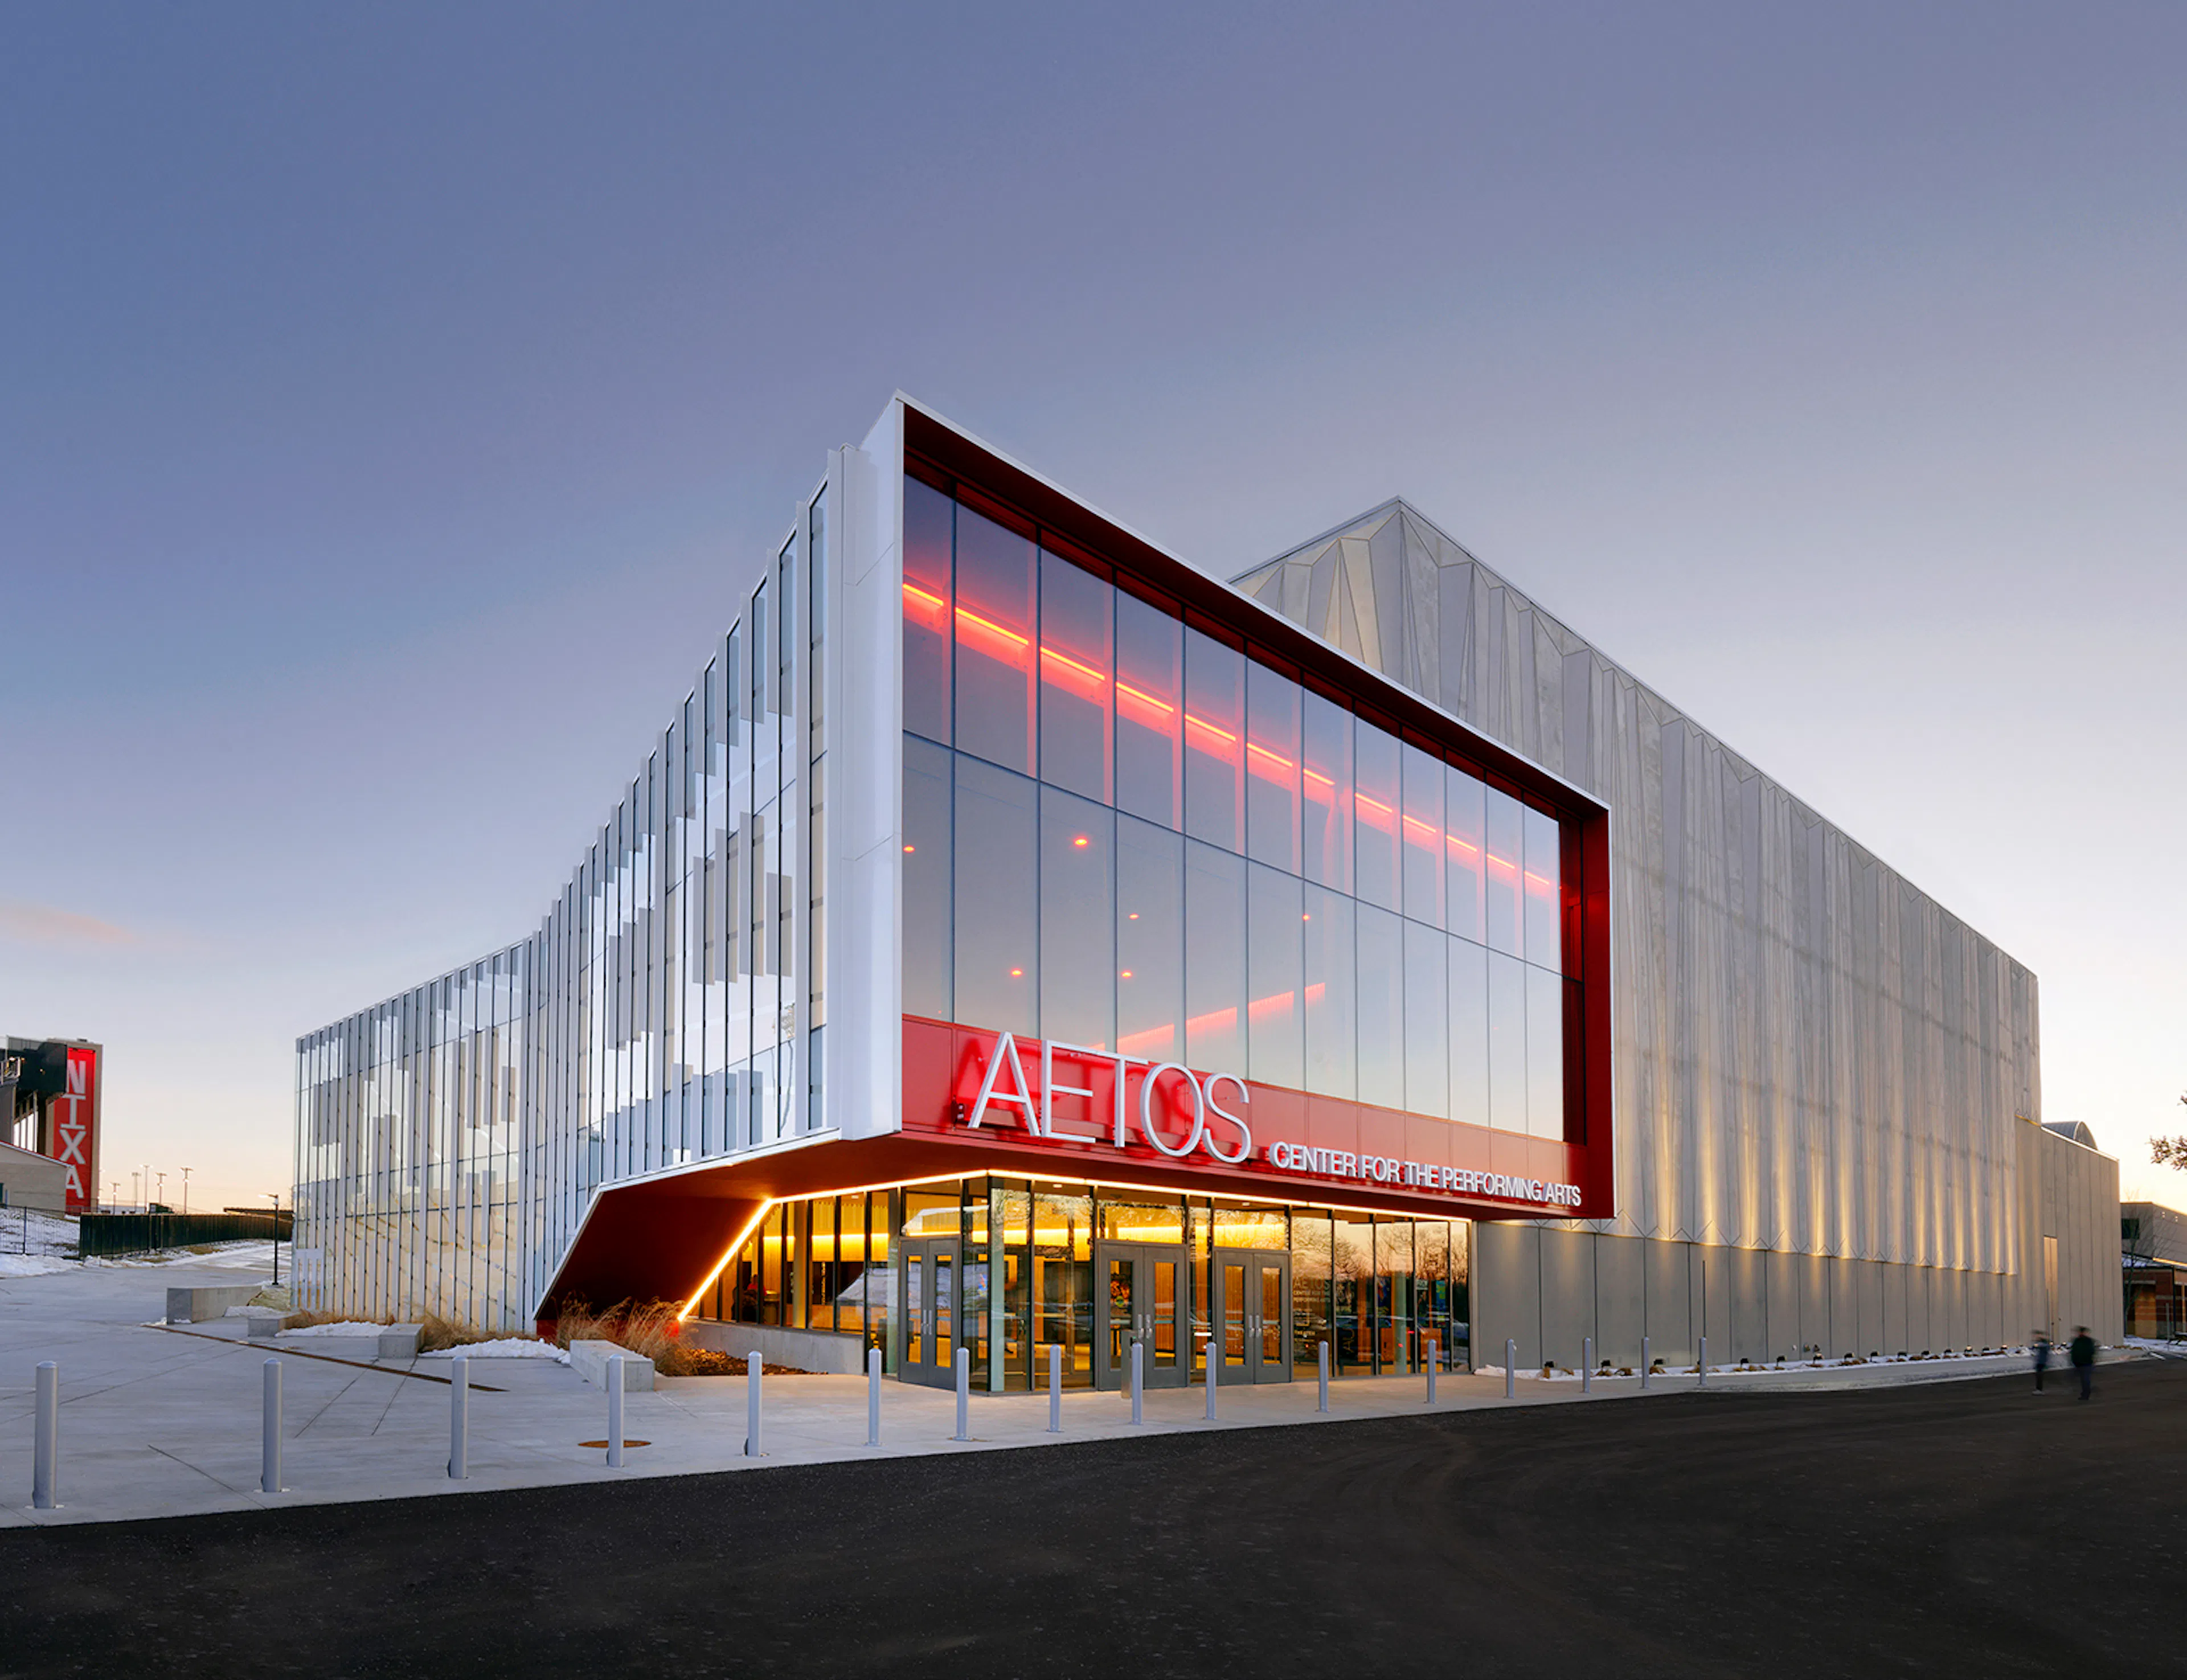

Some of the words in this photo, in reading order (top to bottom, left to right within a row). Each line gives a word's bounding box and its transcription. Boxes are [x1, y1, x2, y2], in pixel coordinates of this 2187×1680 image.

[59, 1059, 87, 1199] NIXA
[968, 1031, 1251, 1163] AETOS
[1269, 1141, 1357, 1177] CENTER
[1358, 1154, 1400, 1183] FOR
[1400, 1161, 1439, 1188] THE
[1439, 1166, 1542, 1202] PERFORMING
[1543, 1182, 1582, 1207] ARTS
